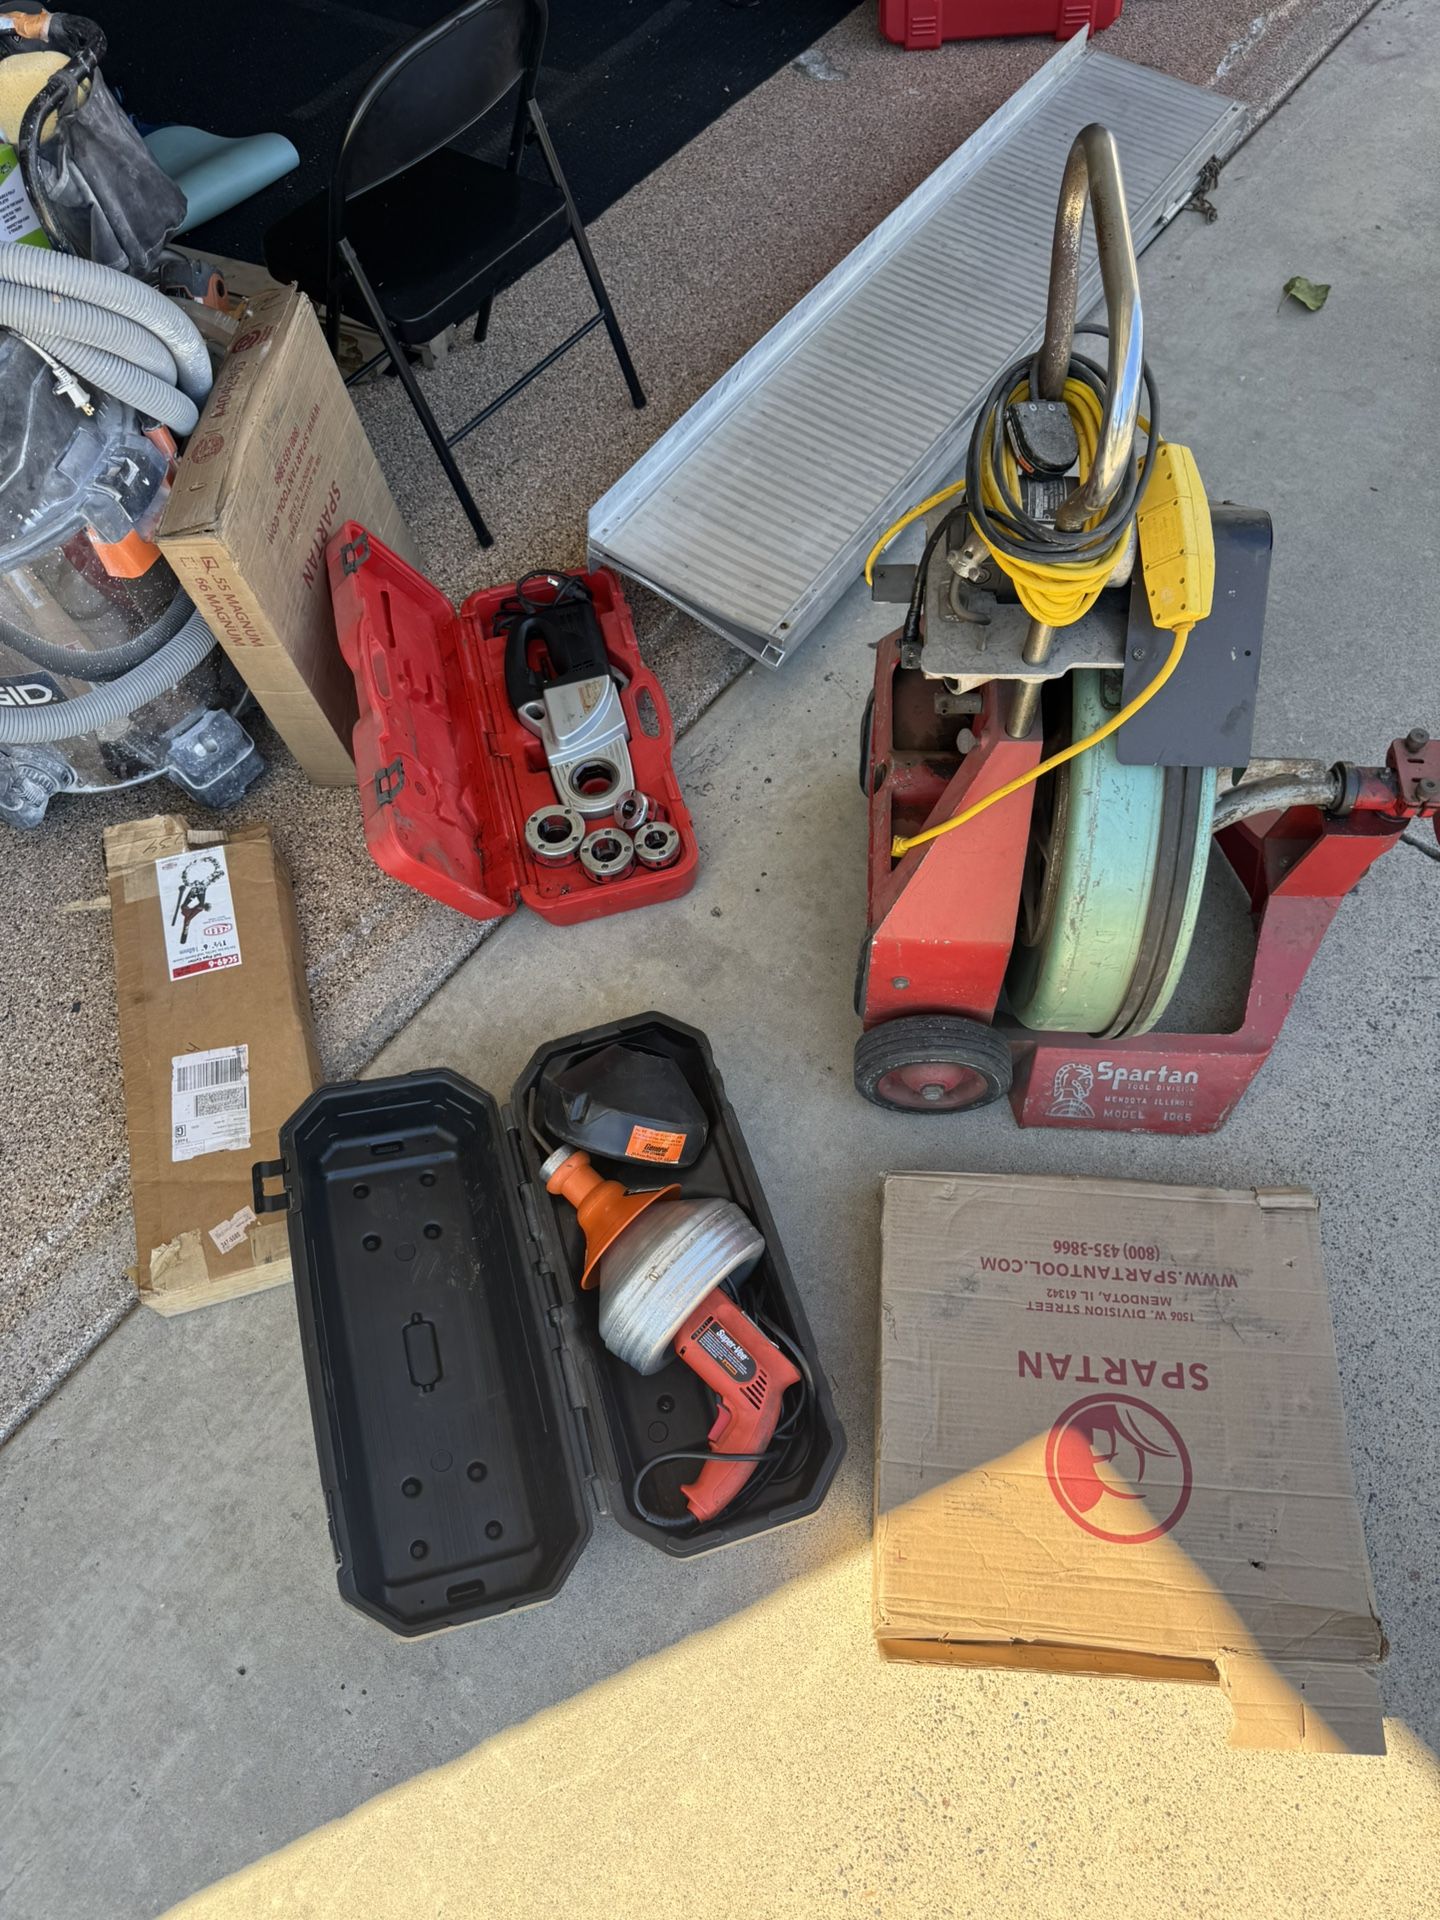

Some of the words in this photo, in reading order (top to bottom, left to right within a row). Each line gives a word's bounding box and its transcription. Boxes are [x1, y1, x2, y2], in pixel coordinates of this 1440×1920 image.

[303, 480, 341, 589] SPARTAN
[204, 594, 246, 647] MAGNUM
[224, 594, 264, 647] MAGNUM
[208, 955, 238, 968] SC49-6
[1097, 1061, 1199, 1090] Spartan
[1103, 1109, 1146, 1119] MODEL
[1163, 1111, 1192, 1121] 1065
[1053, 1239, 1120, 1258] 435-3866
[1123, 1242, 1160, 1261] (800)
[980, 1256, 1238, 1288] WWW.SPARTANTOOL.COM
[1046, 1288, 1077, 1299] 61342
[1080, 1290, 1094, 1300] IL
[1099, 1290, 1172, 1306] MENDOTA,
[1026, 1300, 1080, 1315] STREET
[1084, 1304, 1146, 1319] DIVISION
[1153, 1311, 1168, 1321] W.
[1170, 1312, 1195, 1322] 1506
[1018, 1350, 1209, 1391] SPARTAN
